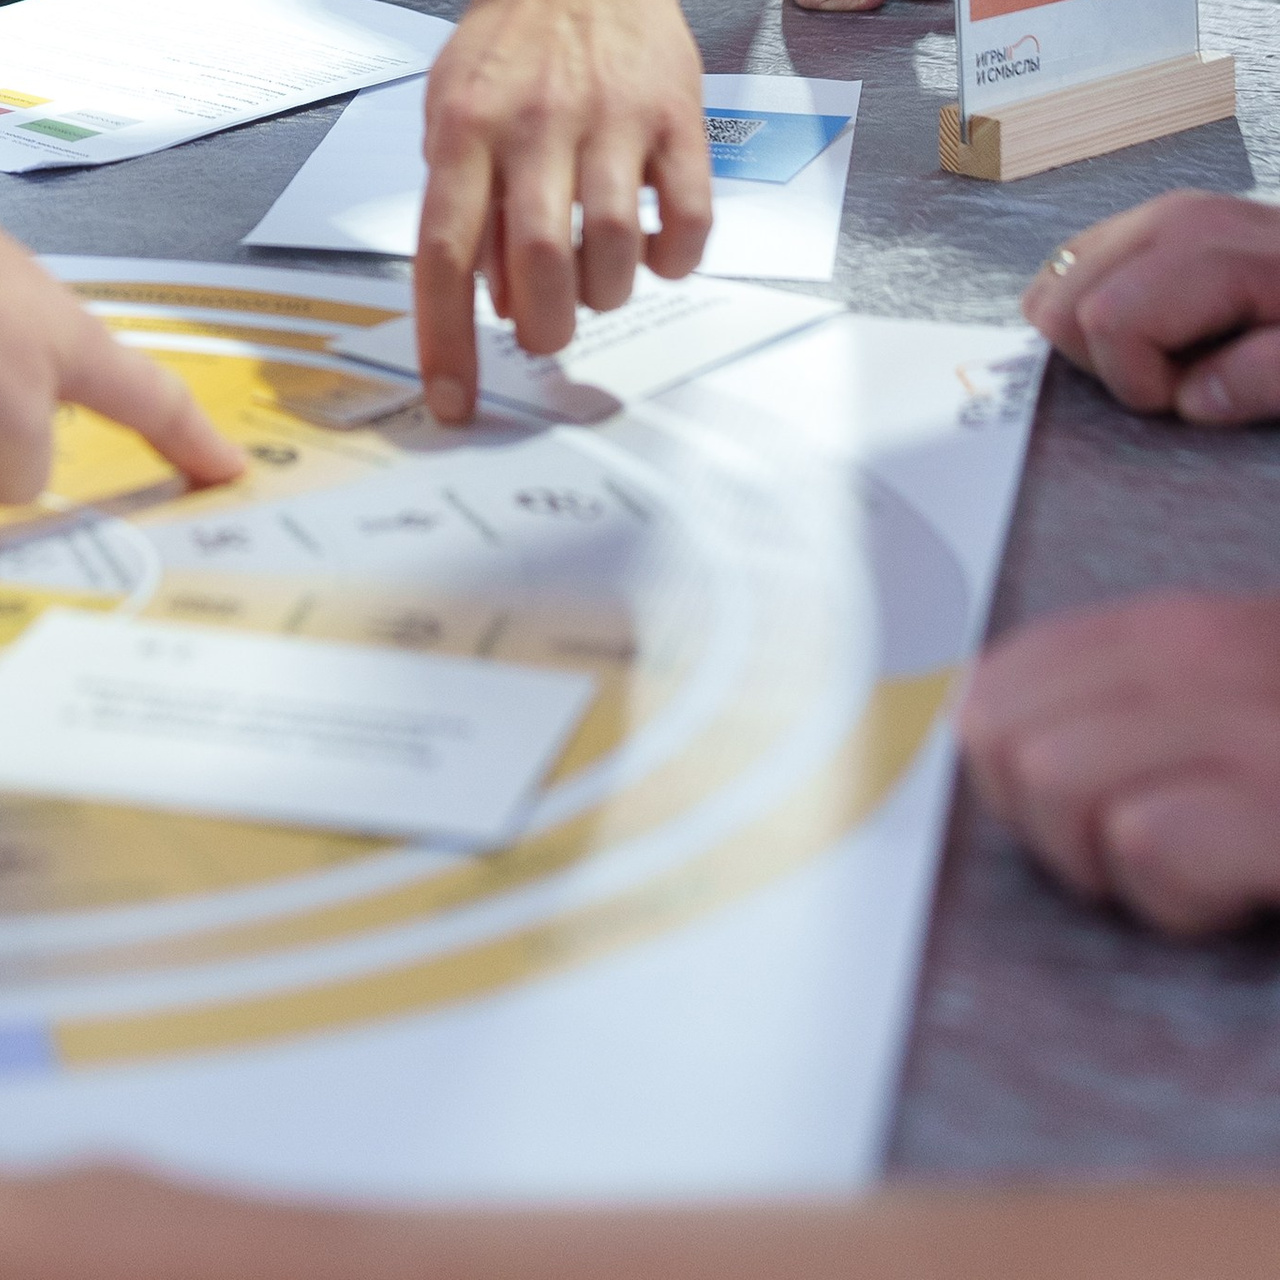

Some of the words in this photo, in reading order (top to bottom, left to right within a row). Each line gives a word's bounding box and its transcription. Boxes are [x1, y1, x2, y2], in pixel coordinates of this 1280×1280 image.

[975, 46, 1008, 69] ИГРЫ
[976, 69, 986, 86] И
[987, 55, 1041, 83] СМЫСЛЫ
